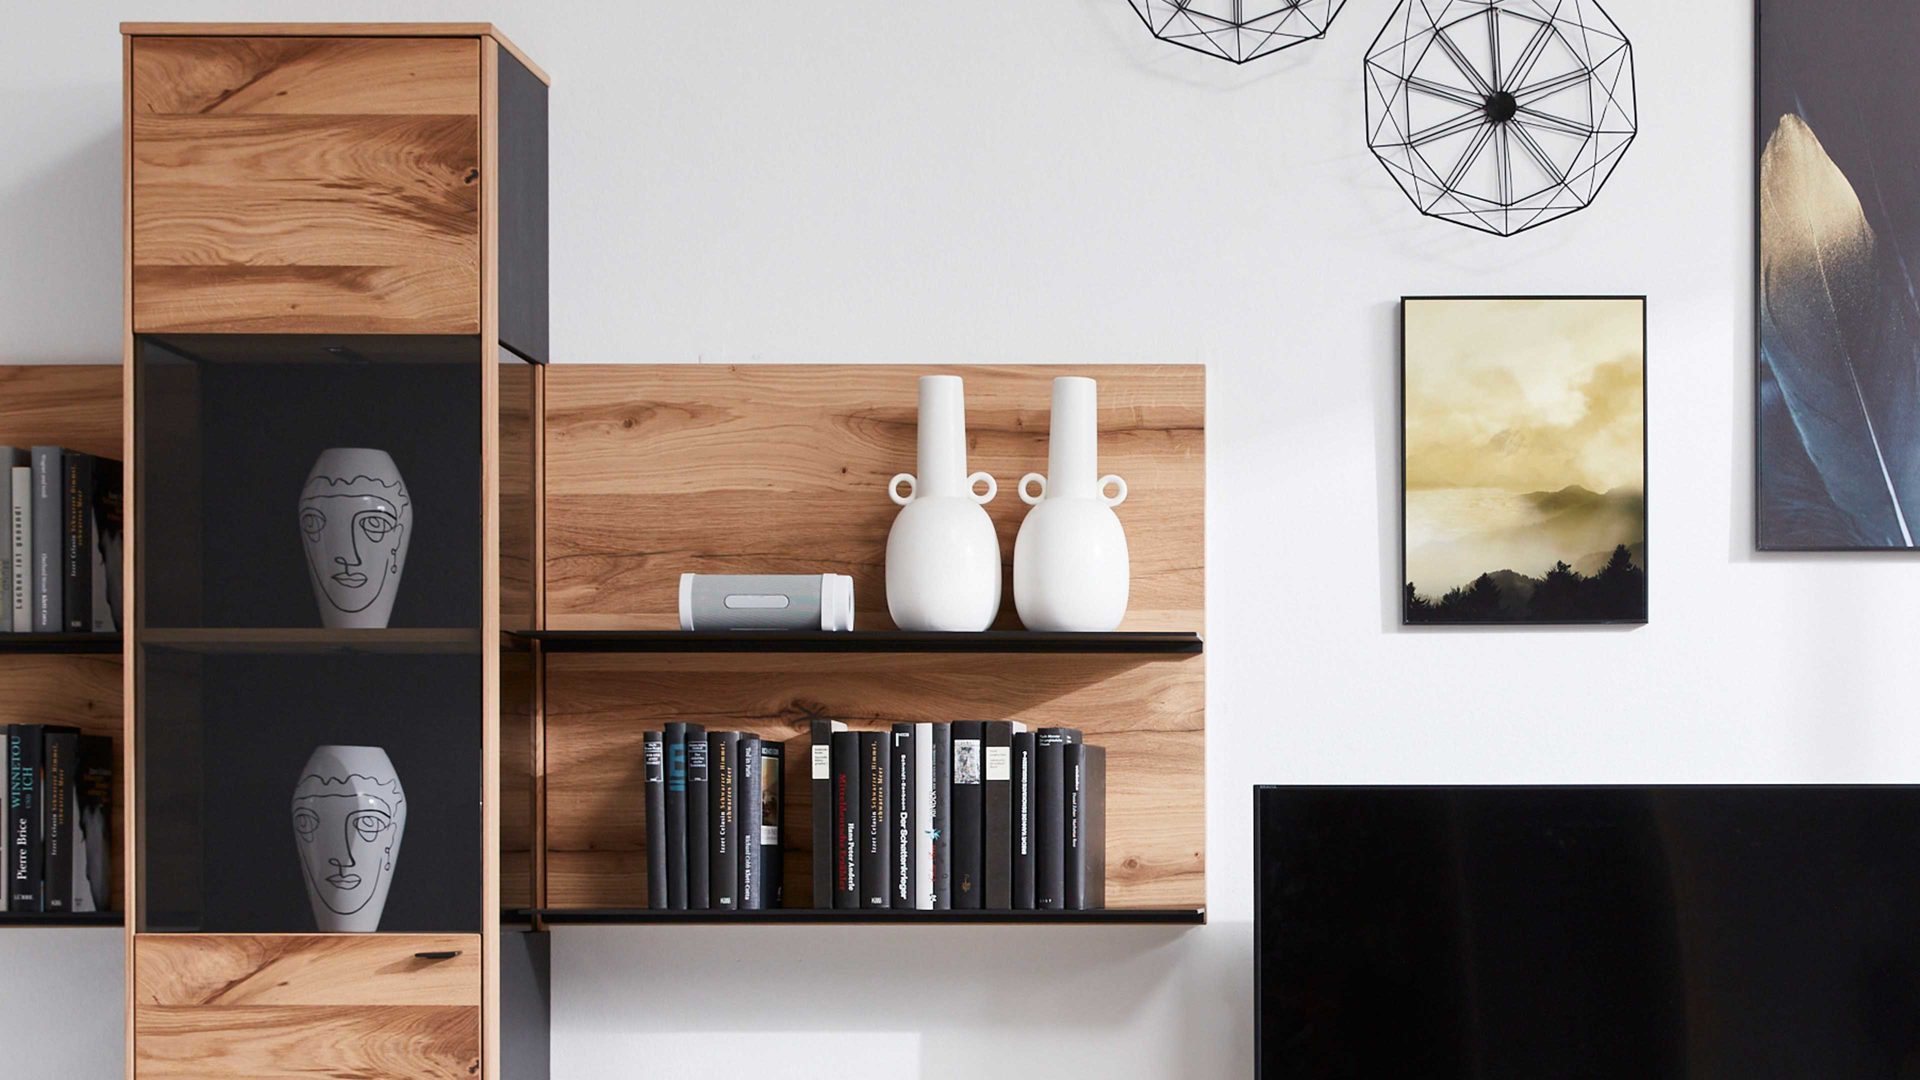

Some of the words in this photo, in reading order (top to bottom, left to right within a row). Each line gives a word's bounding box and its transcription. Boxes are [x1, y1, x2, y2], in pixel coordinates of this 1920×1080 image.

[11, 736, 21, 808] WINNETOU
[22, 767, 32, 791] ICH
[16, 818, 28, 845] Brice
[900, 812, 908, 828] Der
[16, 848, 28, 880] Pierre
[898, 829, 908, 900] Schattenkrieger
